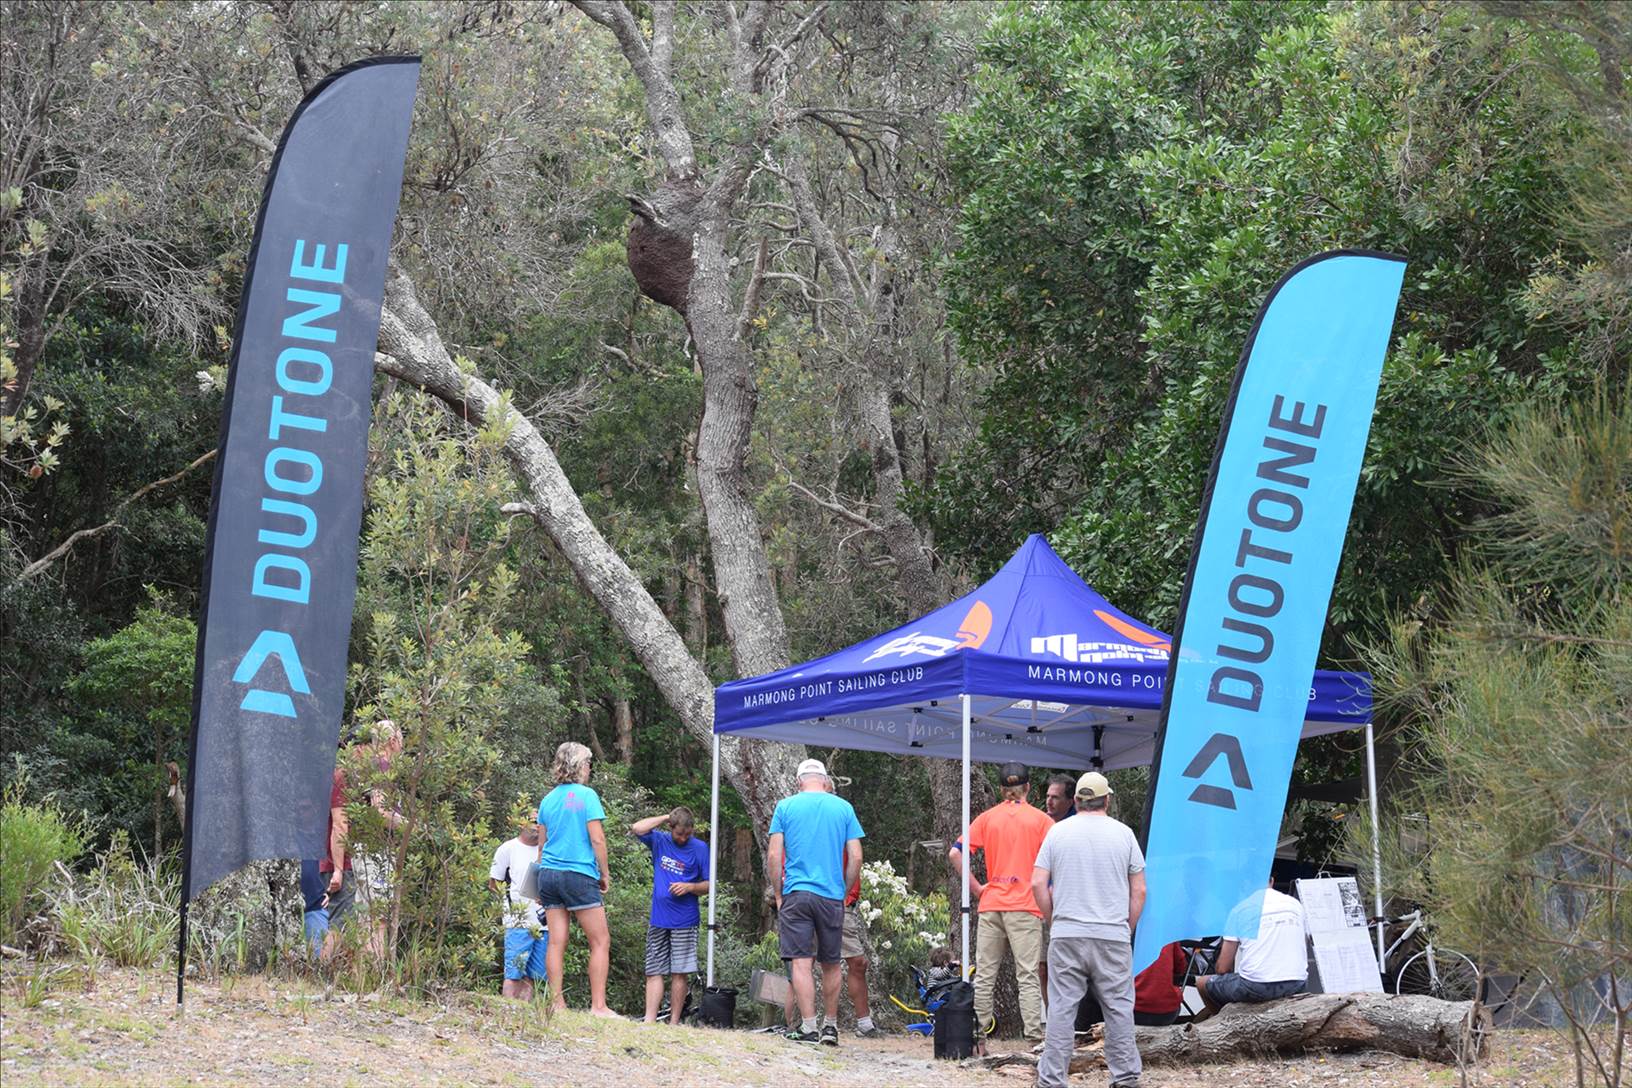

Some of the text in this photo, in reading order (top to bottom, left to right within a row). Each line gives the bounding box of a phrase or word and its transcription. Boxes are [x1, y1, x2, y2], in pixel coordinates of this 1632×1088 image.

[251, 239, 349, 605] DUOTONE
[1206, 394, 1328, 713] DUOTONE
[743, 666, 924, 709] MARMONG POINT SAILING CLUB
[1028, 664, 1122, 687] MARMONG
